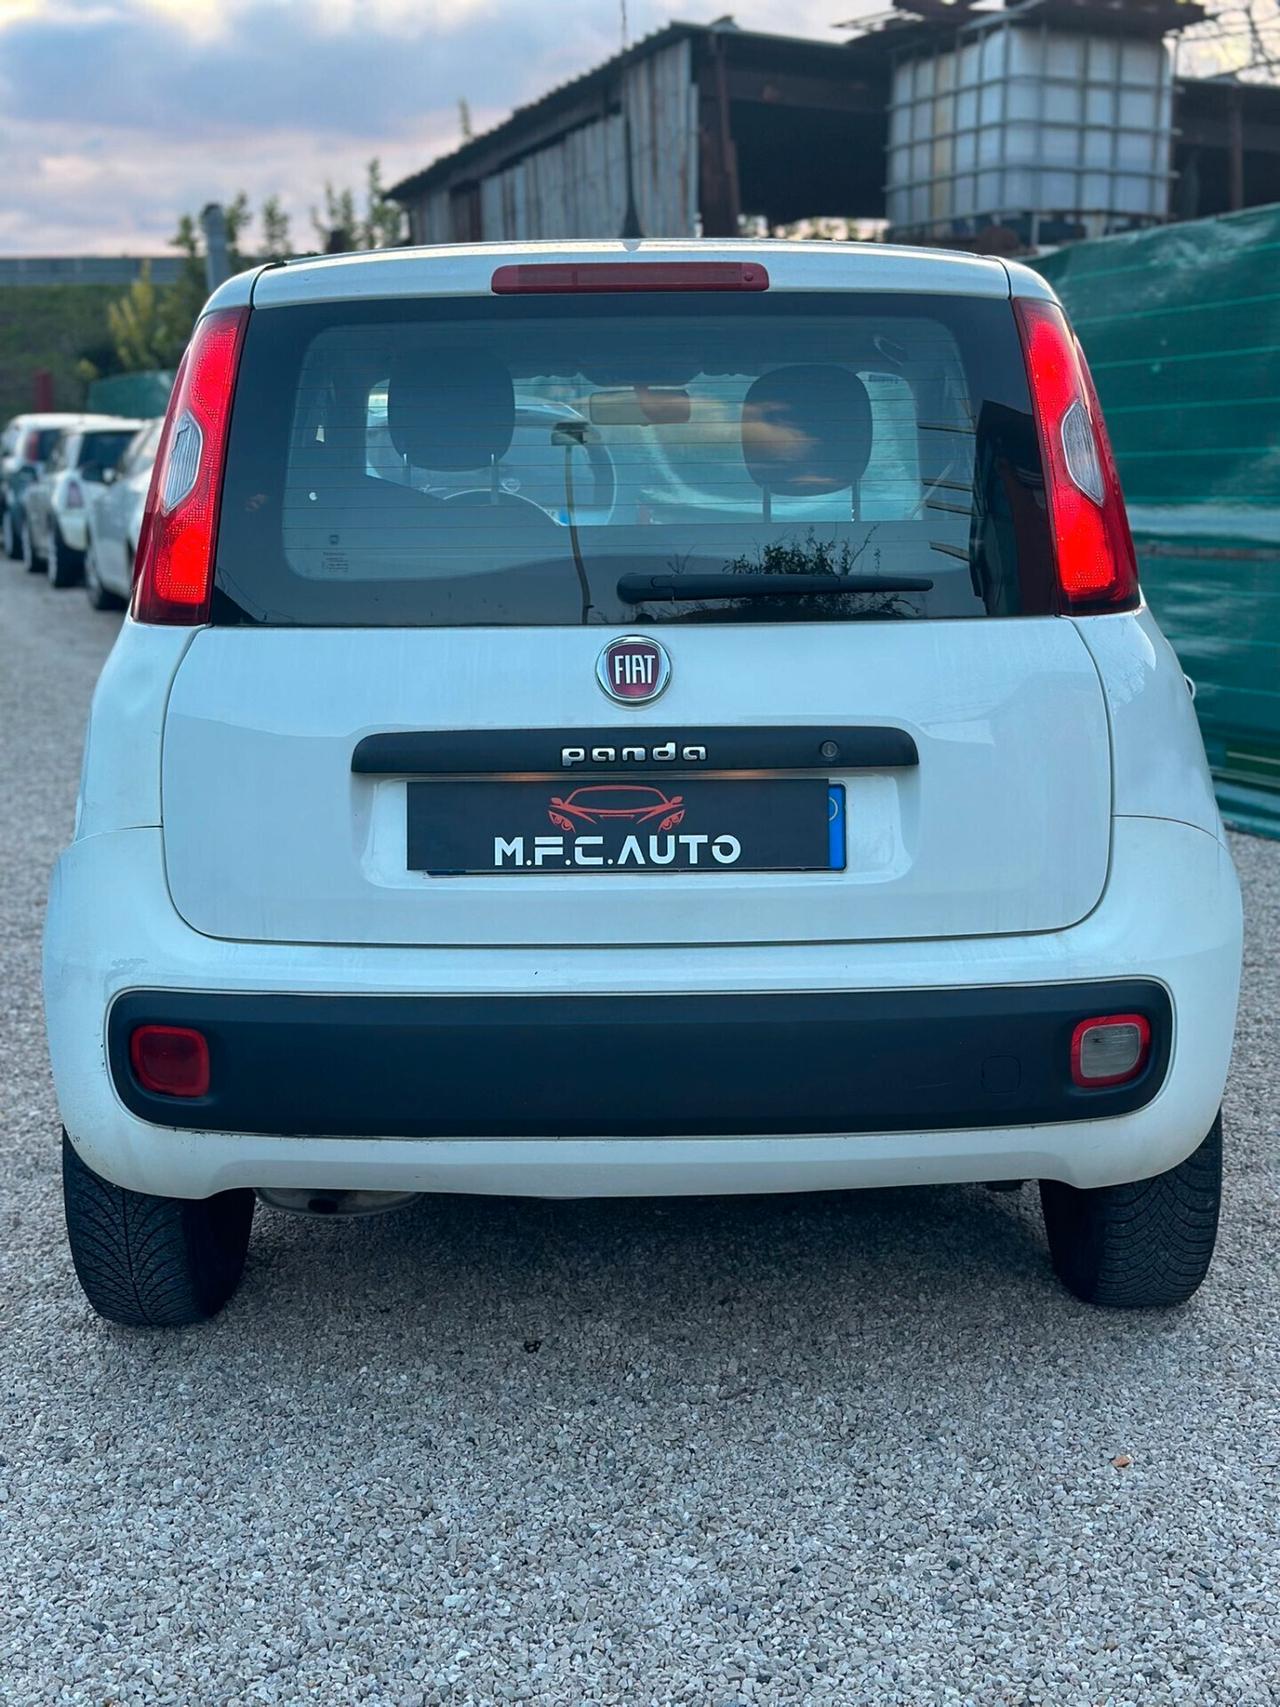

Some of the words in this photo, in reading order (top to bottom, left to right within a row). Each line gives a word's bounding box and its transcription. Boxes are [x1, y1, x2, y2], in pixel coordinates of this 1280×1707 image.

[614, 654, 656, 685] FIAT
[561, 742, 706, 767] panda
[494, 834, 742, 866] M.F.C.AUTO
